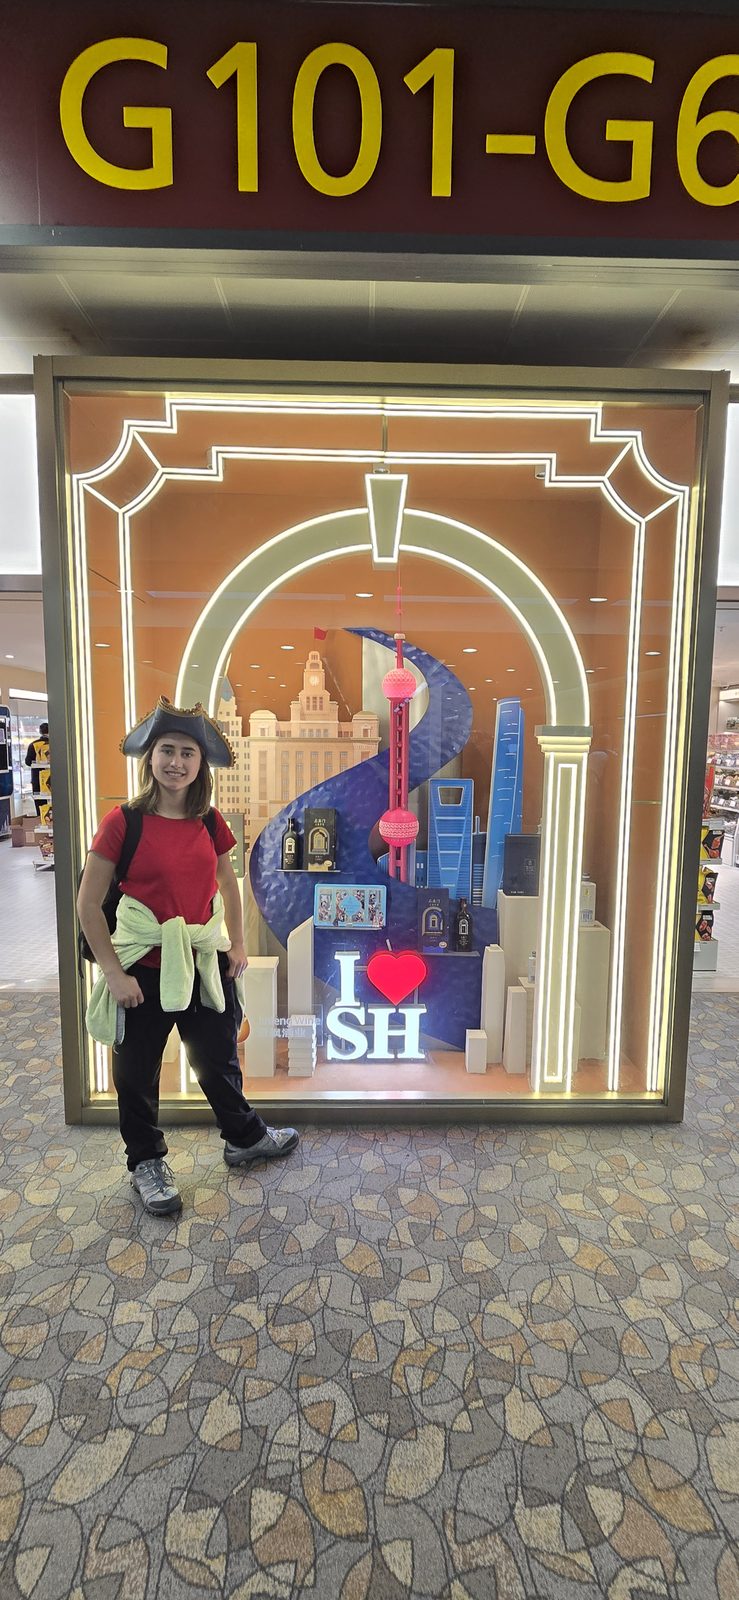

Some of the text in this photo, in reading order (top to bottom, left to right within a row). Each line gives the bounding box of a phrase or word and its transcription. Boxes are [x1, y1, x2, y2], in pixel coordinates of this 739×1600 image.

[59, 37, 739, 207] G101-G6
[334, 951, 361, 1007] I
[326, 1004, 427, 1060] SH
